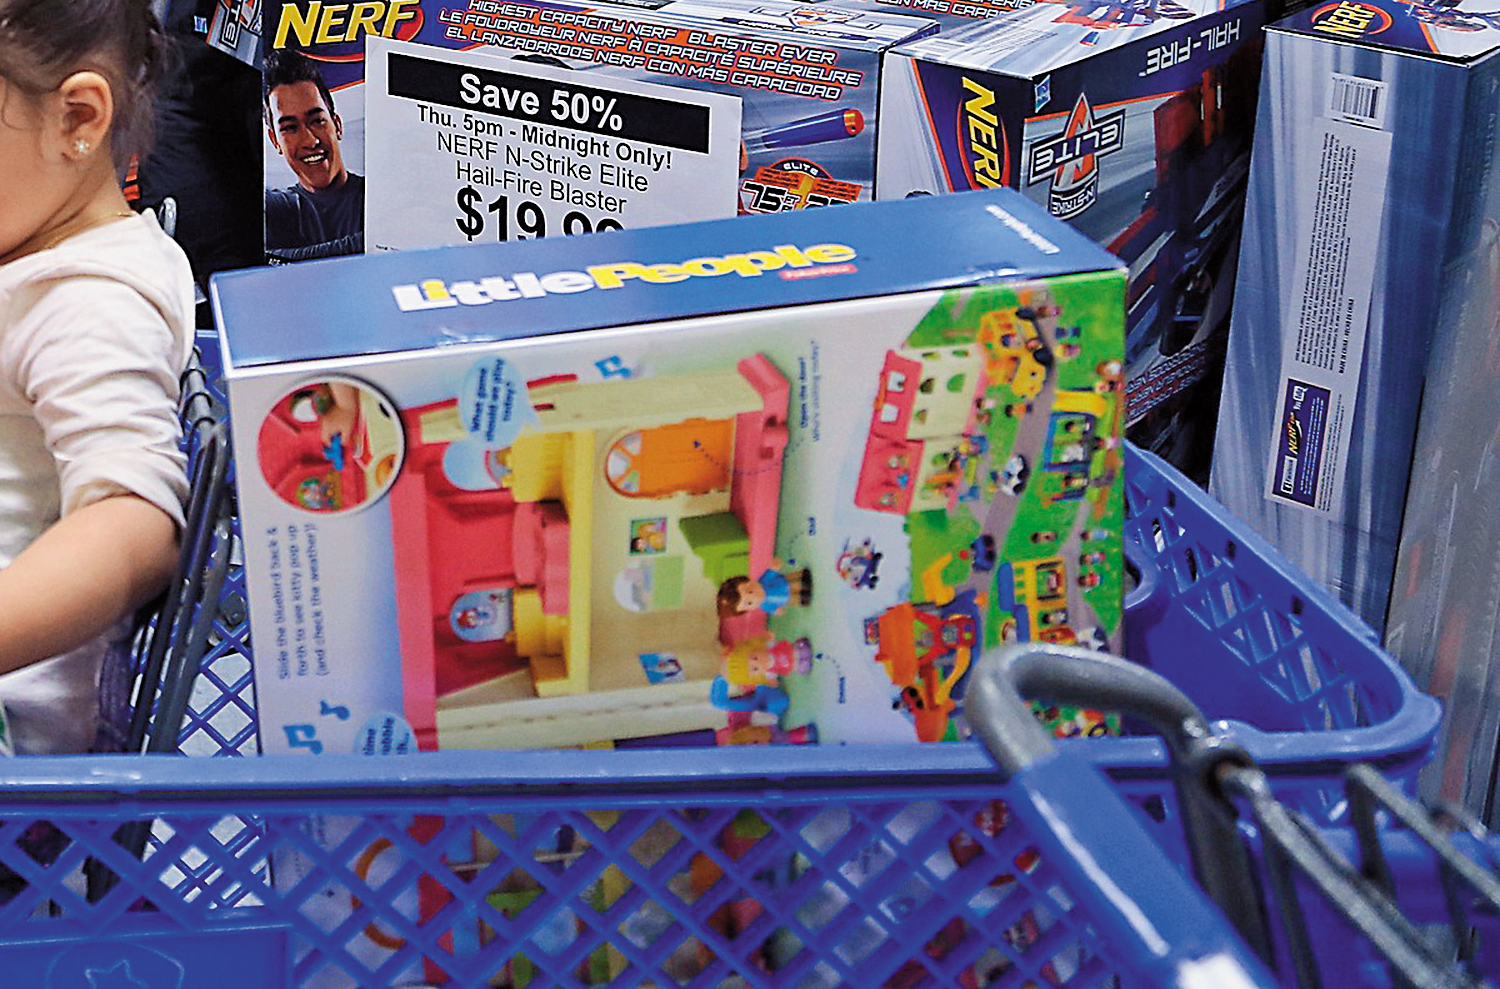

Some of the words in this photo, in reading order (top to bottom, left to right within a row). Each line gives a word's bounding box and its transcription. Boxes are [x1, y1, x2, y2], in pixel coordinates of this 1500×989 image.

[439, 10, 461, 23] LE
[463, 14, 575, 39] FOUDROYEUR
[578, 29, 626, 48] NERF
[629, 30, 642, 51] À
[644, 40, 735, 67] CAPACITÉ
[737, 53, 861, 87] SUPÉRIEURE
[446, 26, 470, 40] EL
[472, 29, 590, 60] LANZADARDOS
[595, 50, 644, 67] NERF
[647, 58, 686, 76] CON
[688, 60, 728, 82] MÁS
[730, 71, 842, 100] CAPACIDAD
[540, 11, 625, 33] CAPACITY
[626, 23, 677, 40] NERF
[688, 32, 777, 56] BLASTER
[779, 47, 836, 65] EVER
[1147, 19, 1241, 74] HAIL-FIRE
[459, 73, 540, 114] Save
[550, 90, 623, 131] 50%
[417, 104, 457, 128] Thu.
[463, 113, 502, 137] 5pm
[522, 124, 609, 159] Midnight
[616, 143, 672, 172] Only!
[437, 131, 498, 161] NERF
[506, 145, 592, 181] N-Strike
[600, 164, 648, 192] Elite
[1036, 122, 1119, 173] ELITE
[456, 161, 542, 197] Hail-Fire
[550, 181, 627, 214] Blaster
[743, 182, 787, 212] 75
